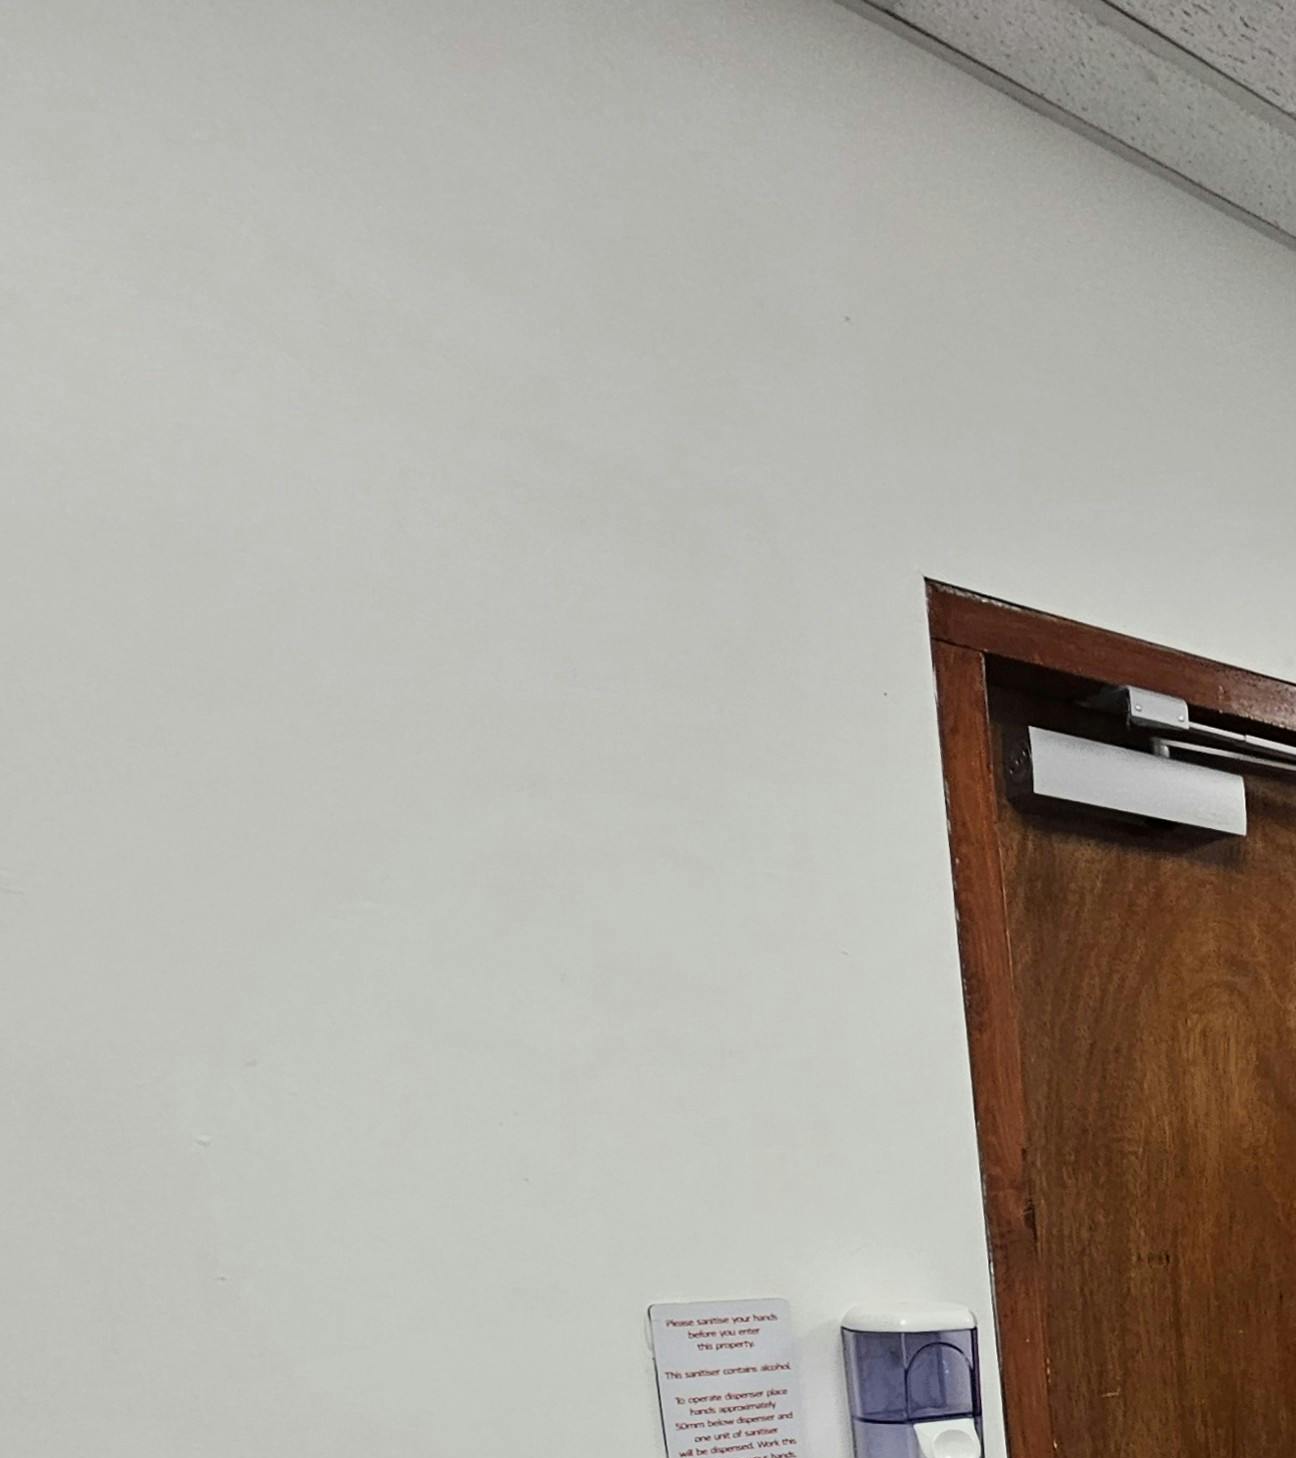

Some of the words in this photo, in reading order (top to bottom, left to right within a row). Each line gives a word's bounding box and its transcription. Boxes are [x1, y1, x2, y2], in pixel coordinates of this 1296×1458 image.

[697, 1318, 729, 1326] sanitise
[731, 1316, 750, 1324] your
[688, 1331, 716, 1339] before
[720, 1330, 736, 1338] you
[665, 1371, 682, 1379] This
[685, 1369, 720, 1378] sanitiser
[723, 1367, 757, 1375] contains
[675, 1397, 685, 1405] To
[688, 1395, 721, 1404] operate
[725, 1391, 763, 1401] dispenser
[766, 1388, 788, 1397] place
[690, 1408, 716, 1416] hands
[719, 1401, 776, 1413] approximately
[675, 1422, 705, 1431] 50mm
[708, 1419, 734, 1427] below
[736, 1414, 775, 1424] dispenser
[694, 1435, 711, 1443] one
[714, 1432, 730, 1440] unit
[732, 1430, 742, 1438] of
[744, 1427, 778, 1436] sanitiser
[679, 1449, 693, 1458] will
[757, 1440, 779, 1448] Work
